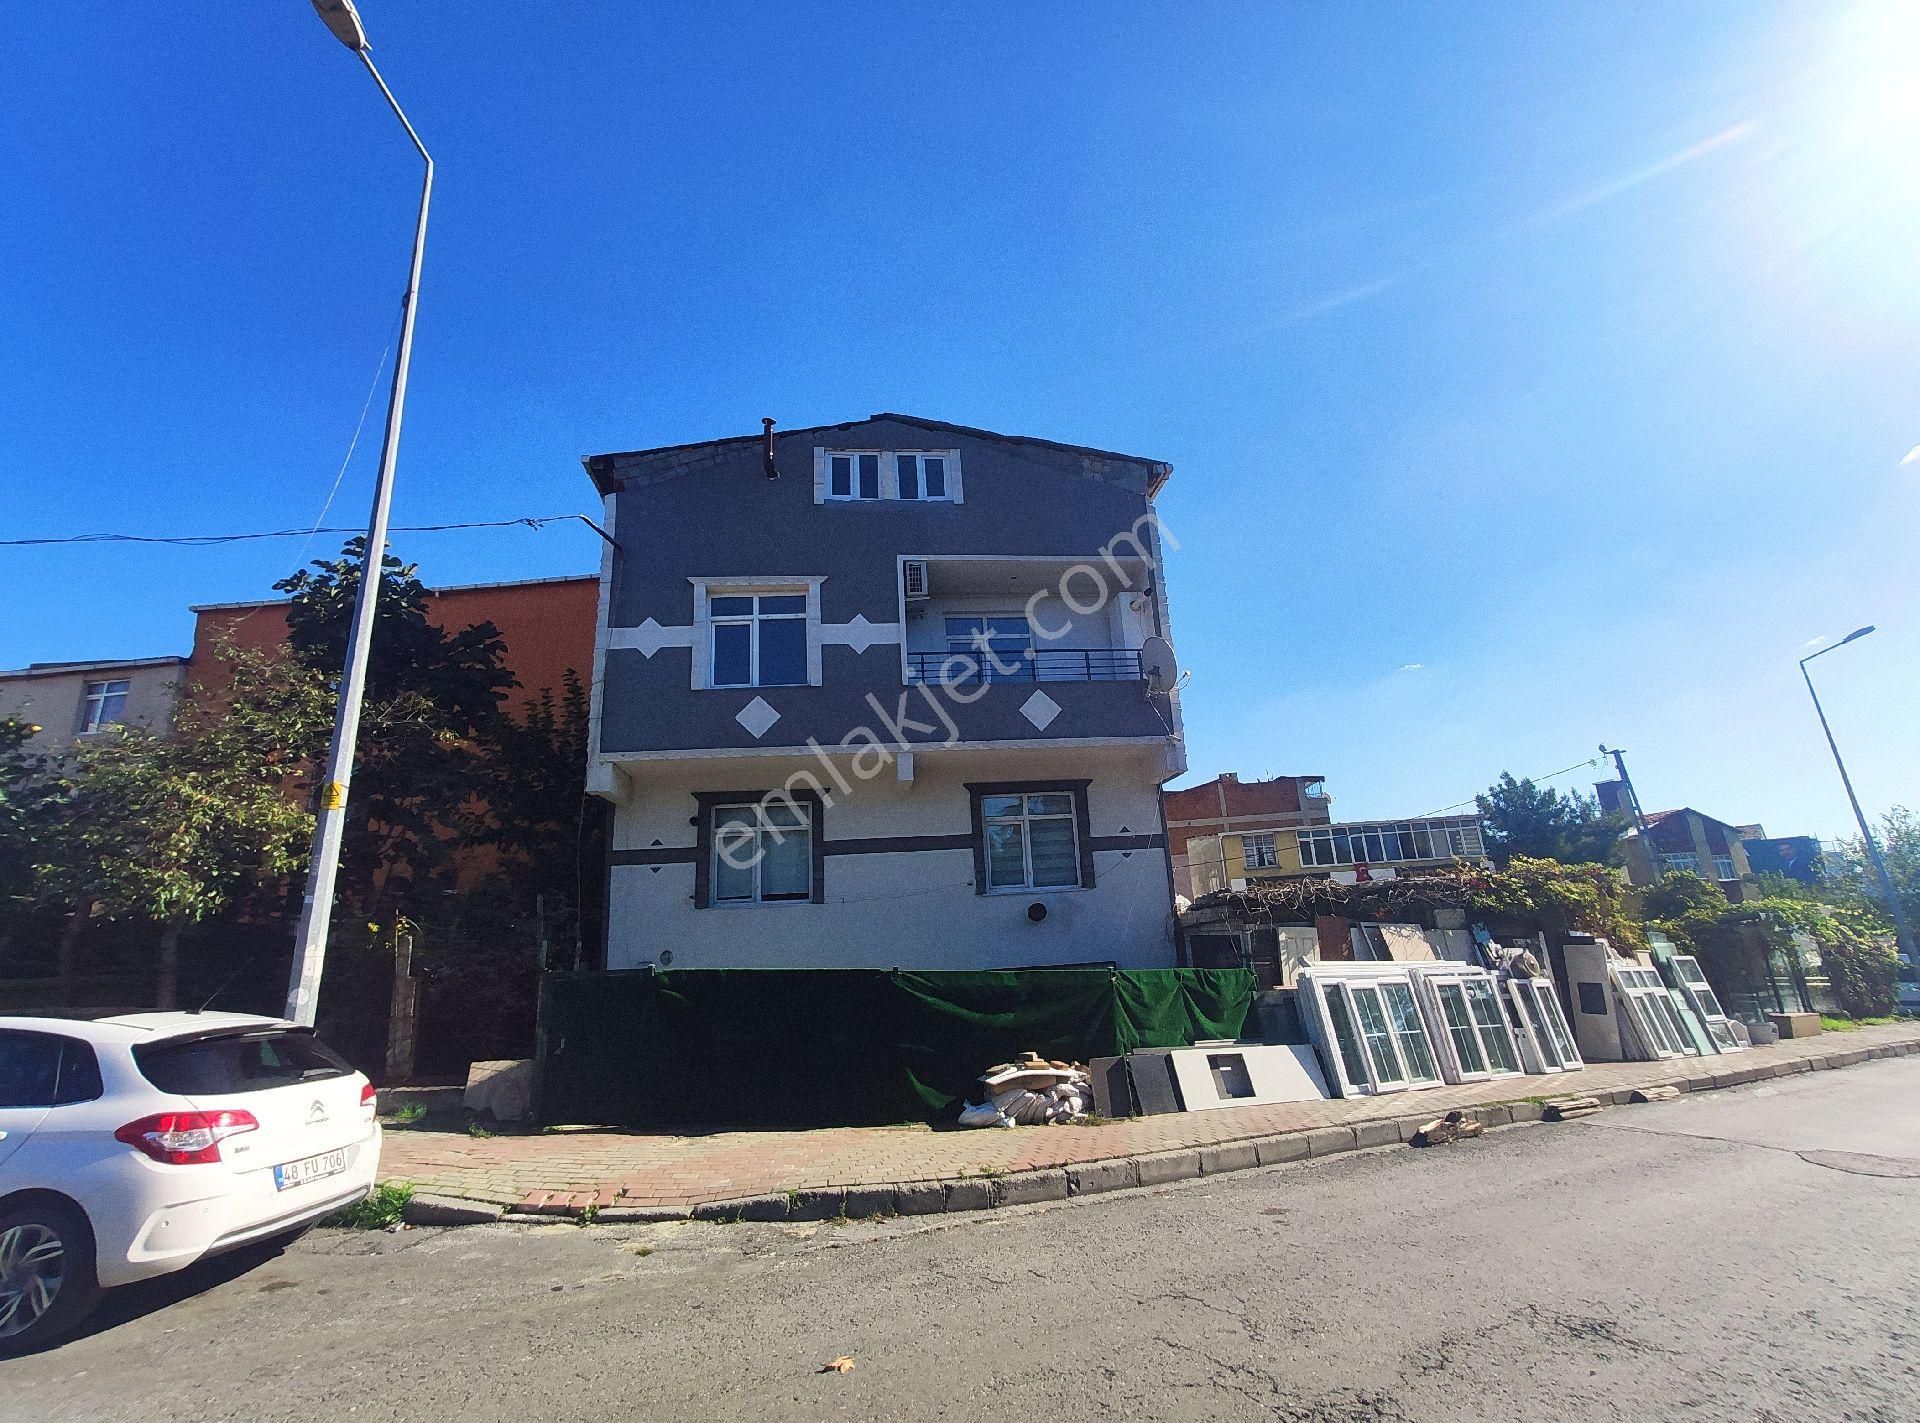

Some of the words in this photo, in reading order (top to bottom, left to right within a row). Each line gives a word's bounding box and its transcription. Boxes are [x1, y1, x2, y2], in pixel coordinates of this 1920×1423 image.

[284, 1165, 299, 1181] 48
[304, 1159, 319, 1176] FU
[322, 1153, 342, 1171] 706
